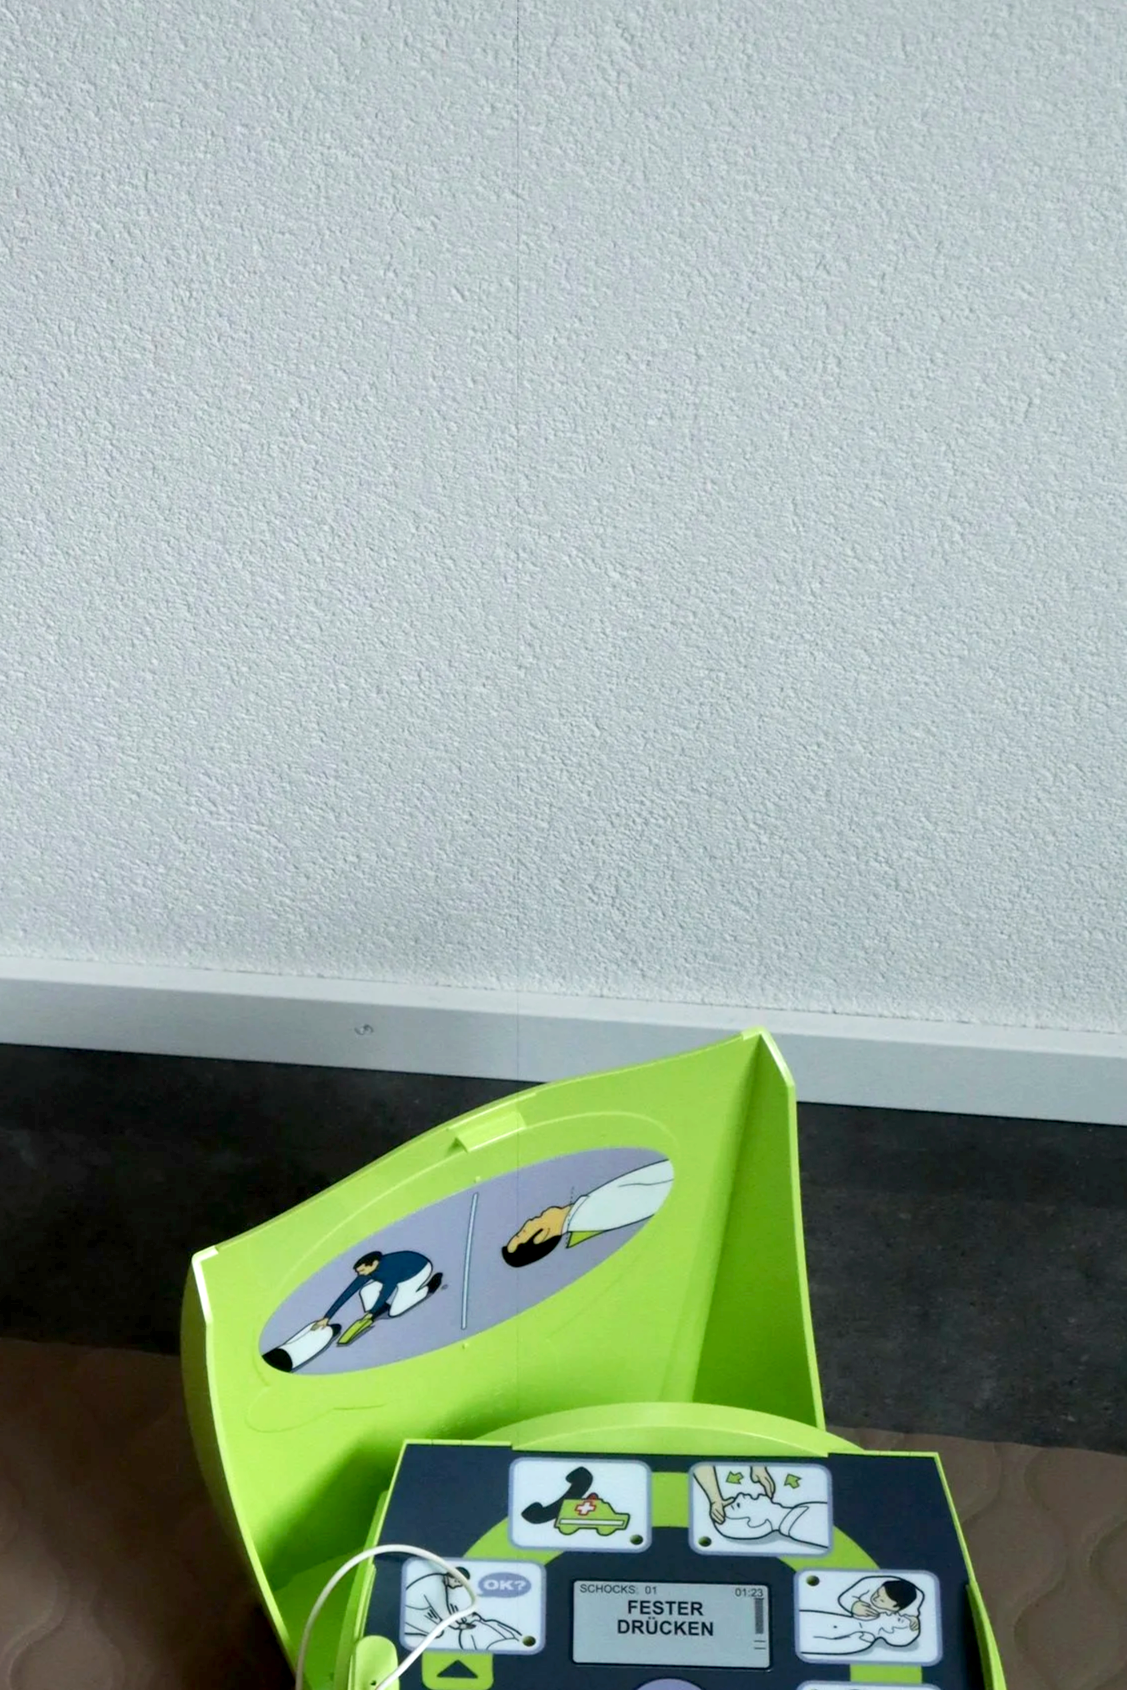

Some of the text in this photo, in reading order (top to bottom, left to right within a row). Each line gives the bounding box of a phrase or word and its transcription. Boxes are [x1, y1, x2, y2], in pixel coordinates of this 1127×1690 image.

[483, 1578, 527, 1592] OK?
[579, 1583, 657, 1595] SCHOCKS: 01
[734, 1587, 764, 1598] 01:23
[627, 1600, 704, 1616] FESTER
[617, 1617, 714, 1637] DRÜCKEN
